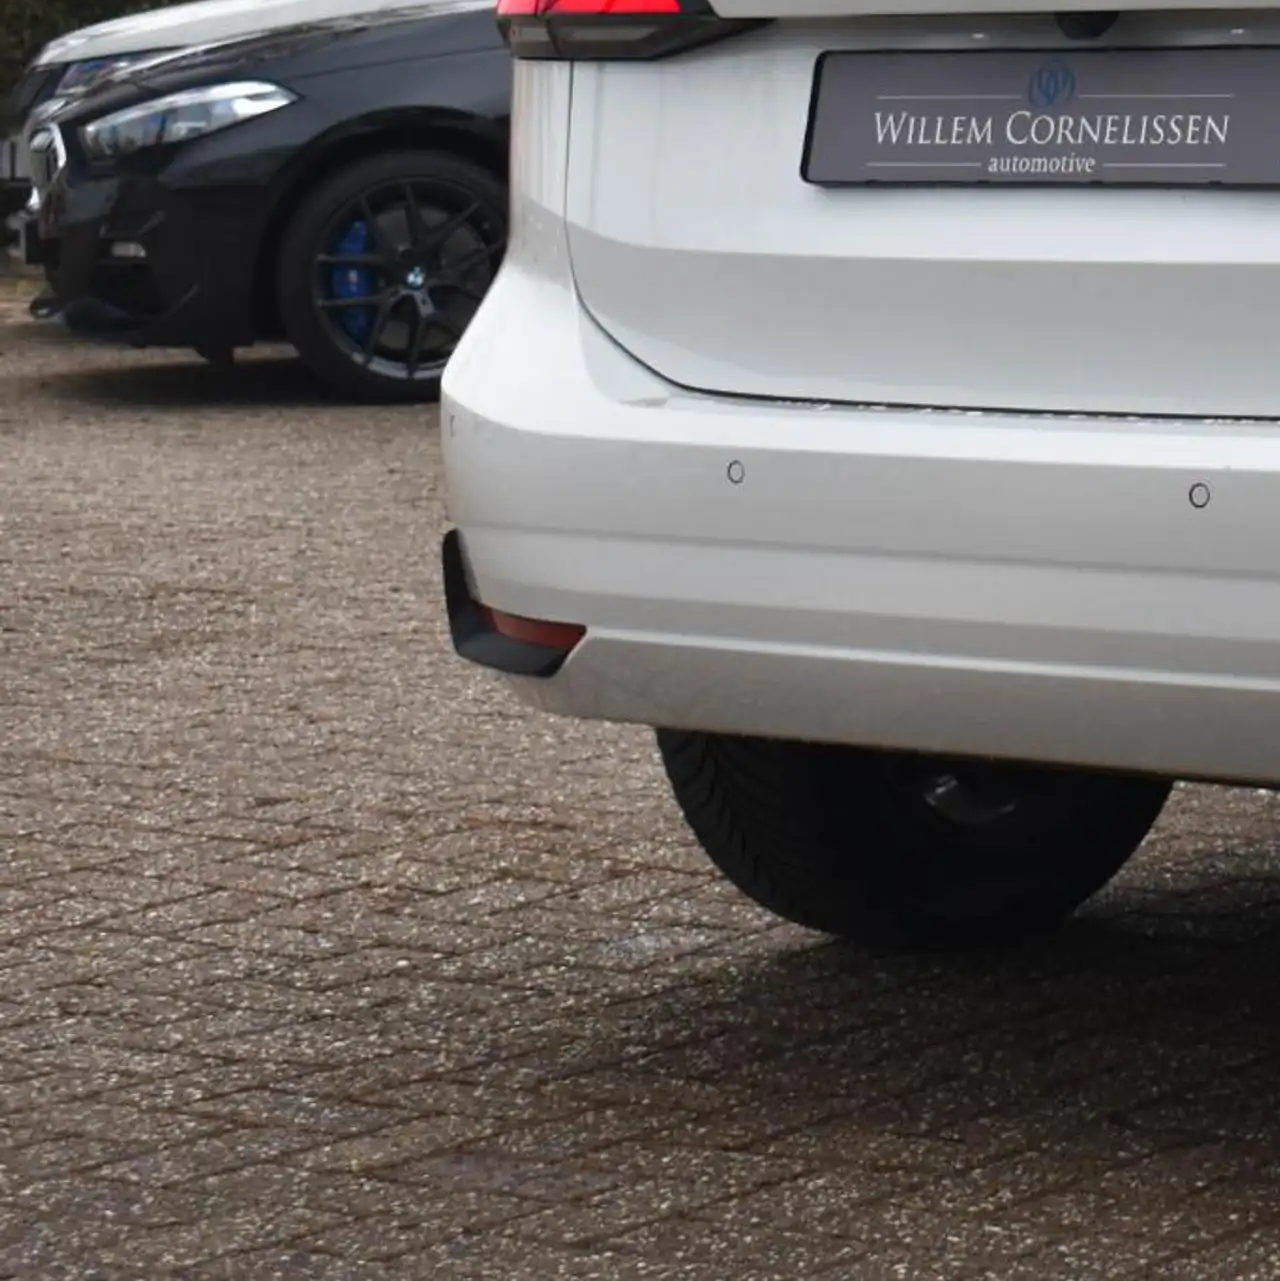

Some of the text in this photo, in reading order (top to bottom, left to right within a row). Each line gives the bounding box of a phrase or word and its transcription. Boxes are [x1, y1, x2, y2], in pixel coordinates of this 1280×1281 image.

[874, 111, 1231, 145] WILLEM CORNELISSEN
[987, 152, 1096, 174] automotive
